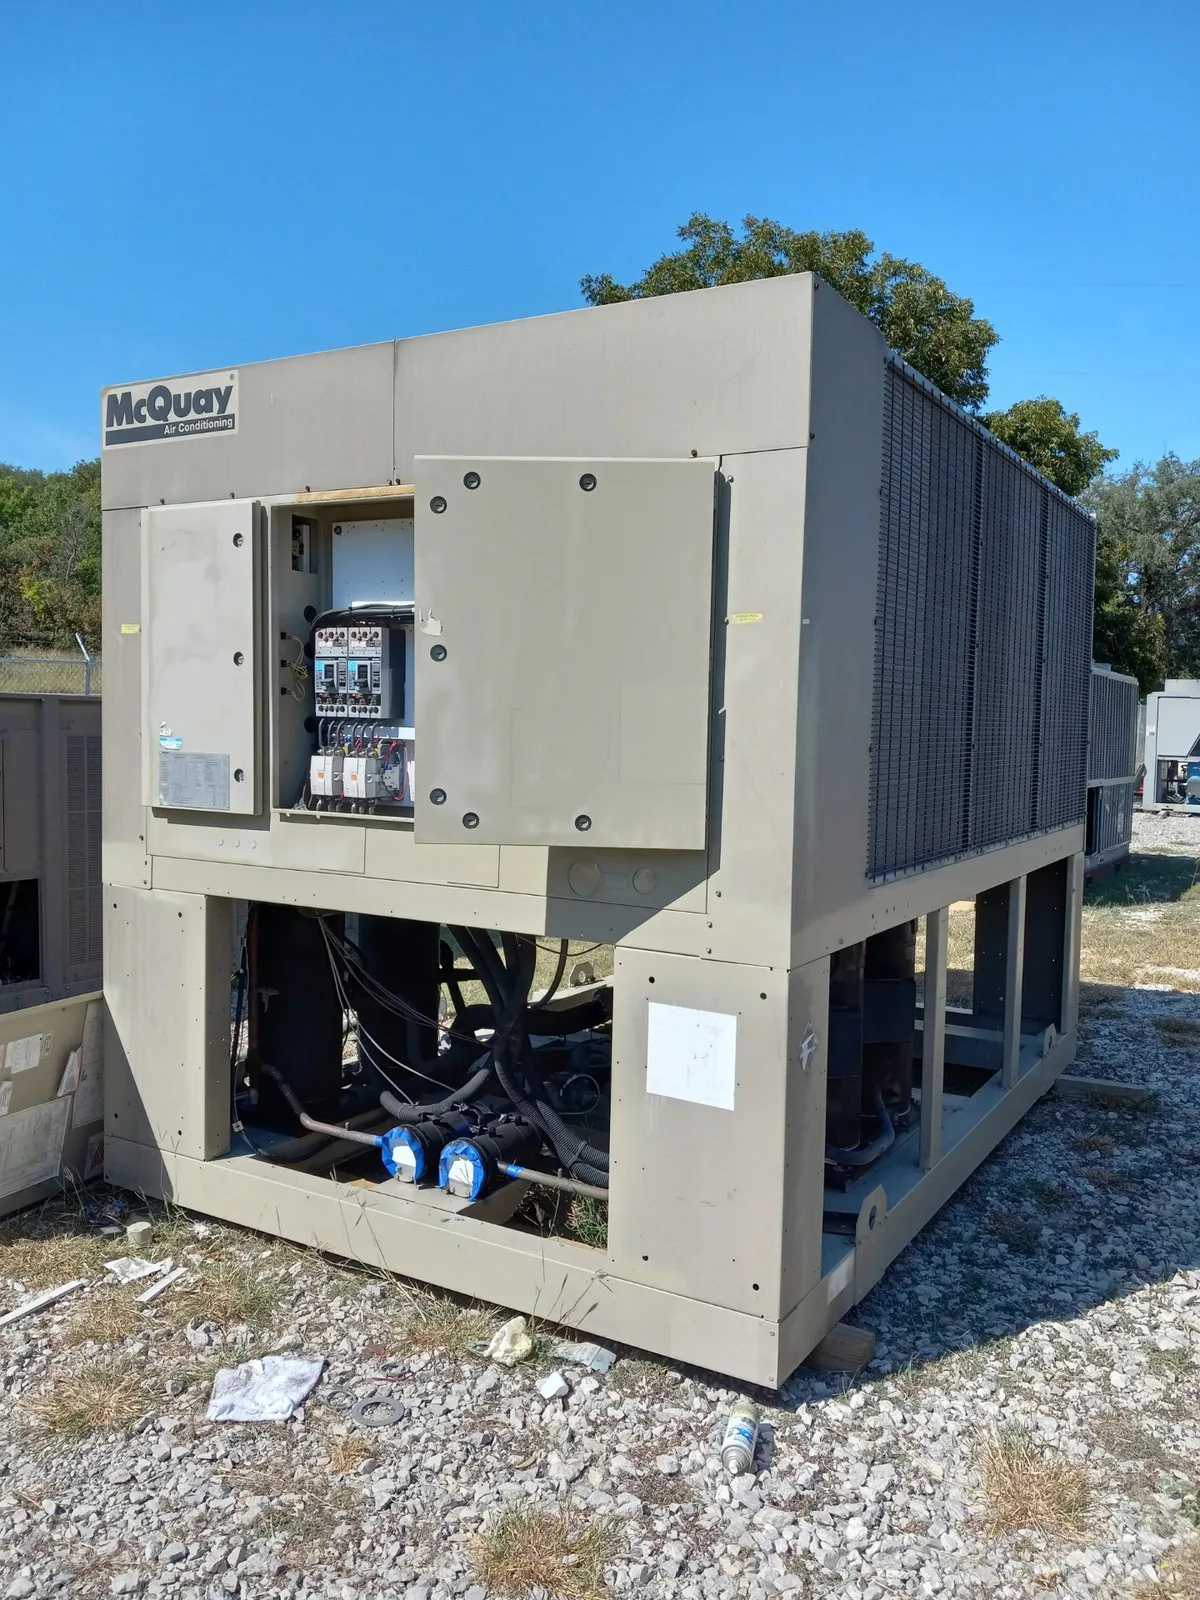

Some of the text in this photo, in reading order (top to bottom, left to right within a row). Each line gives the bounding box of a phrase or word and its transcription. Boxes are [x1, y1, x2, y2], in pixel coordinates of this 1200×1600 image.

[106, 385, 234, 428] McQuay
[163, 417, 234, 435] Air Conditioning
